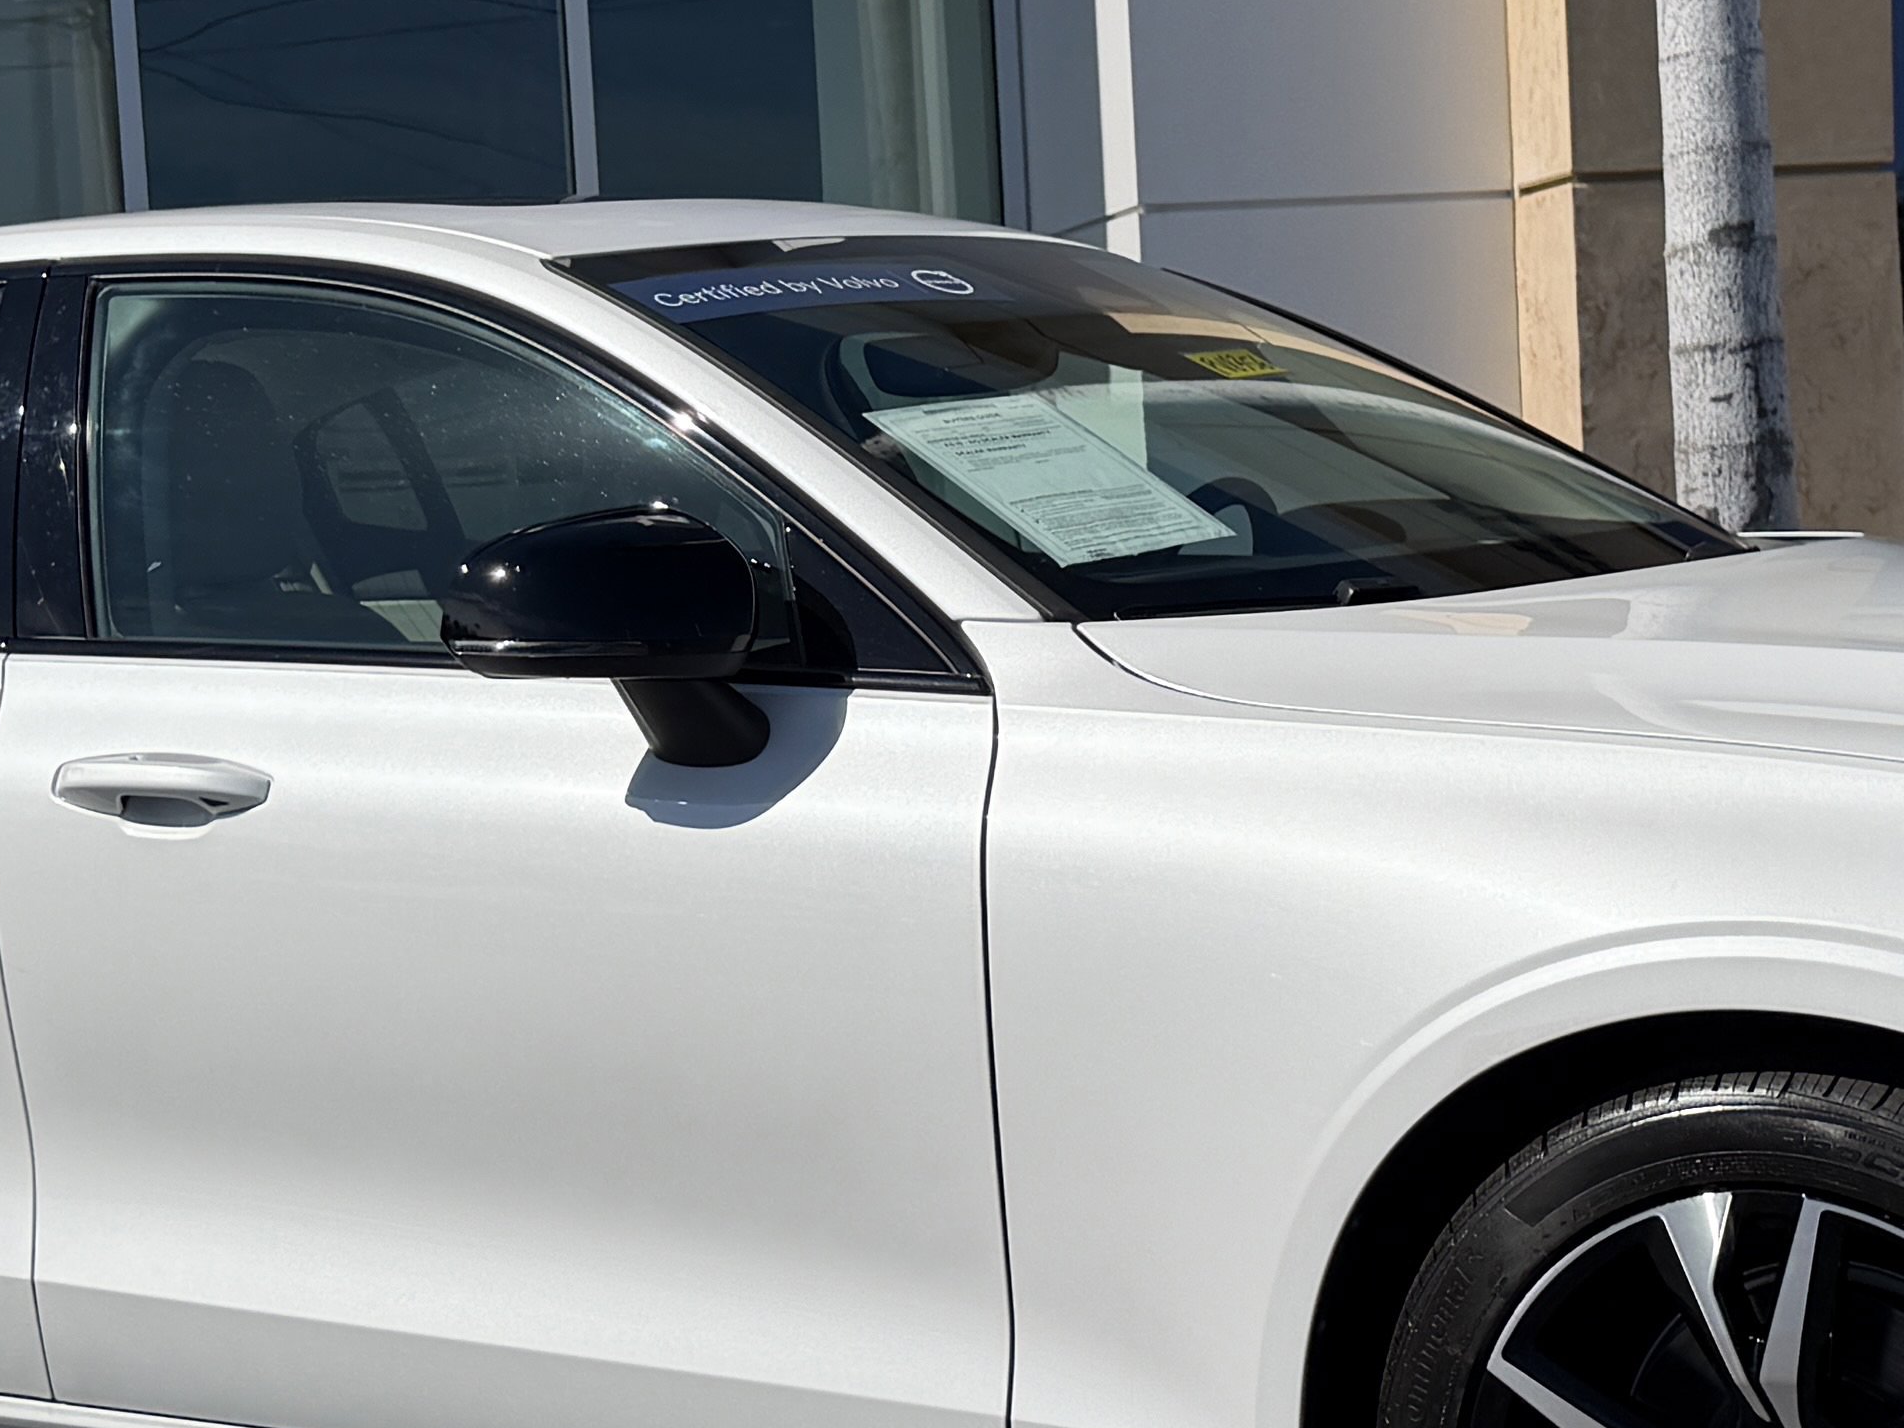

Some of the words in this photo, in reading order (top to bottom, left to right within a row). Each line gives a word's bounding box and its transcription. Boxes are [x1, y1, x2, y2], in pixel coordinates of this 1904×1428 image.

[653, 279, 783, 308] Certified
[778, 278, 823, 295] by
[816, 275, 900, 290] Volvo
